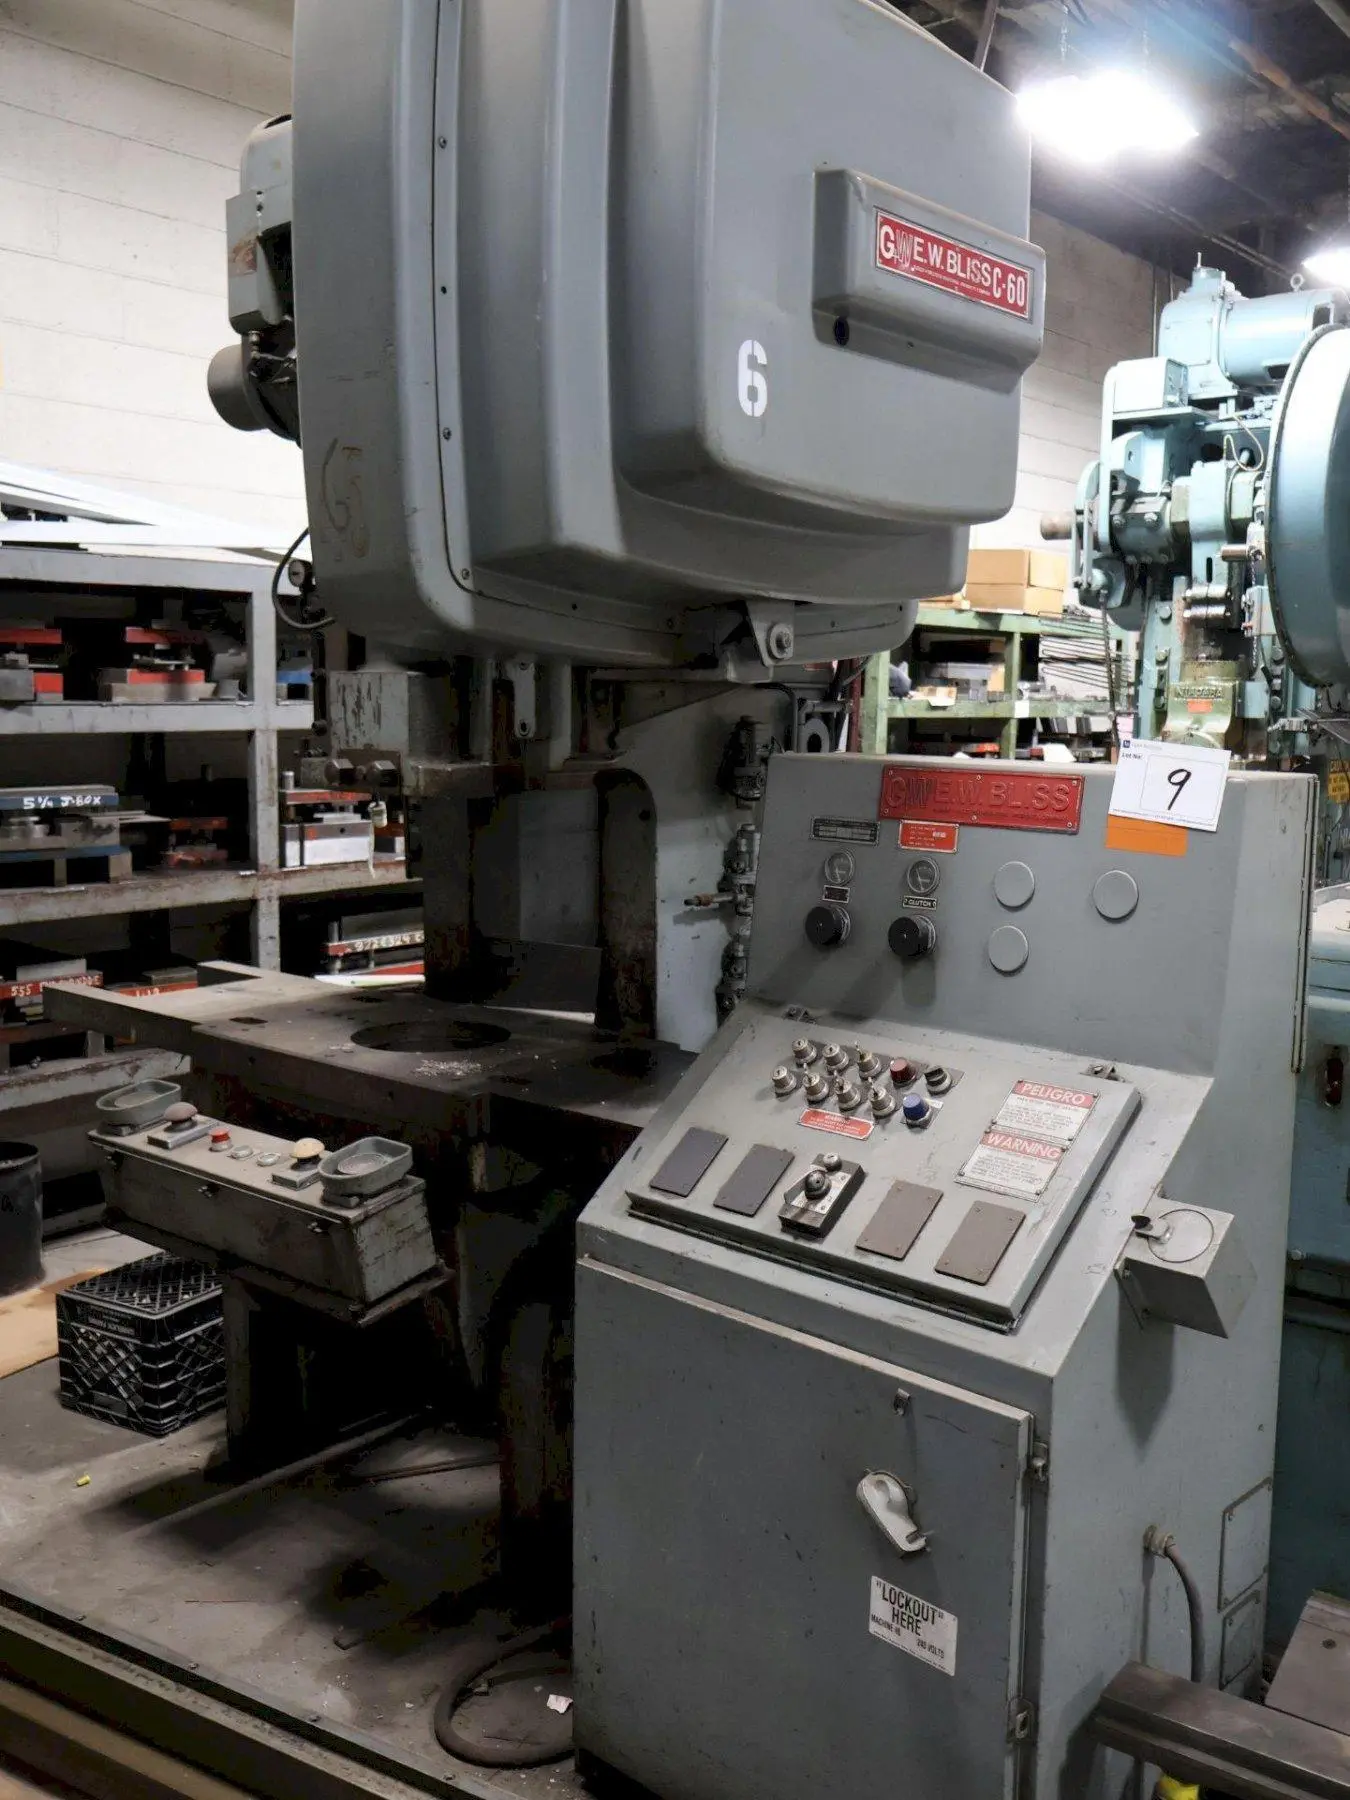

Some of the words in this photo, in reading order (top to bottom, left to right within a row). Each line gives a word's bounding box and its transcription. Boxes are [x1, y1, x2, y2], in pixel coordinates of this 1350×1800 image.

[946, 249, 991, 288] BLISS
[992, 266, 1026, 307] C-60
[738, 339, 768, 418] 6
[988, 781, 1070, 812] BLISS
[1167, 768, 1192, 811] 9
[908, 899, 932, 908] CLUTCH
[1020, 1082, 1086, 1106] PELIGRO
[986, 1132, 1061, 1159] WARNING
[871, 1613, 894, 1632] MACHINE
[891, 1606, 922, 1637] HERE
